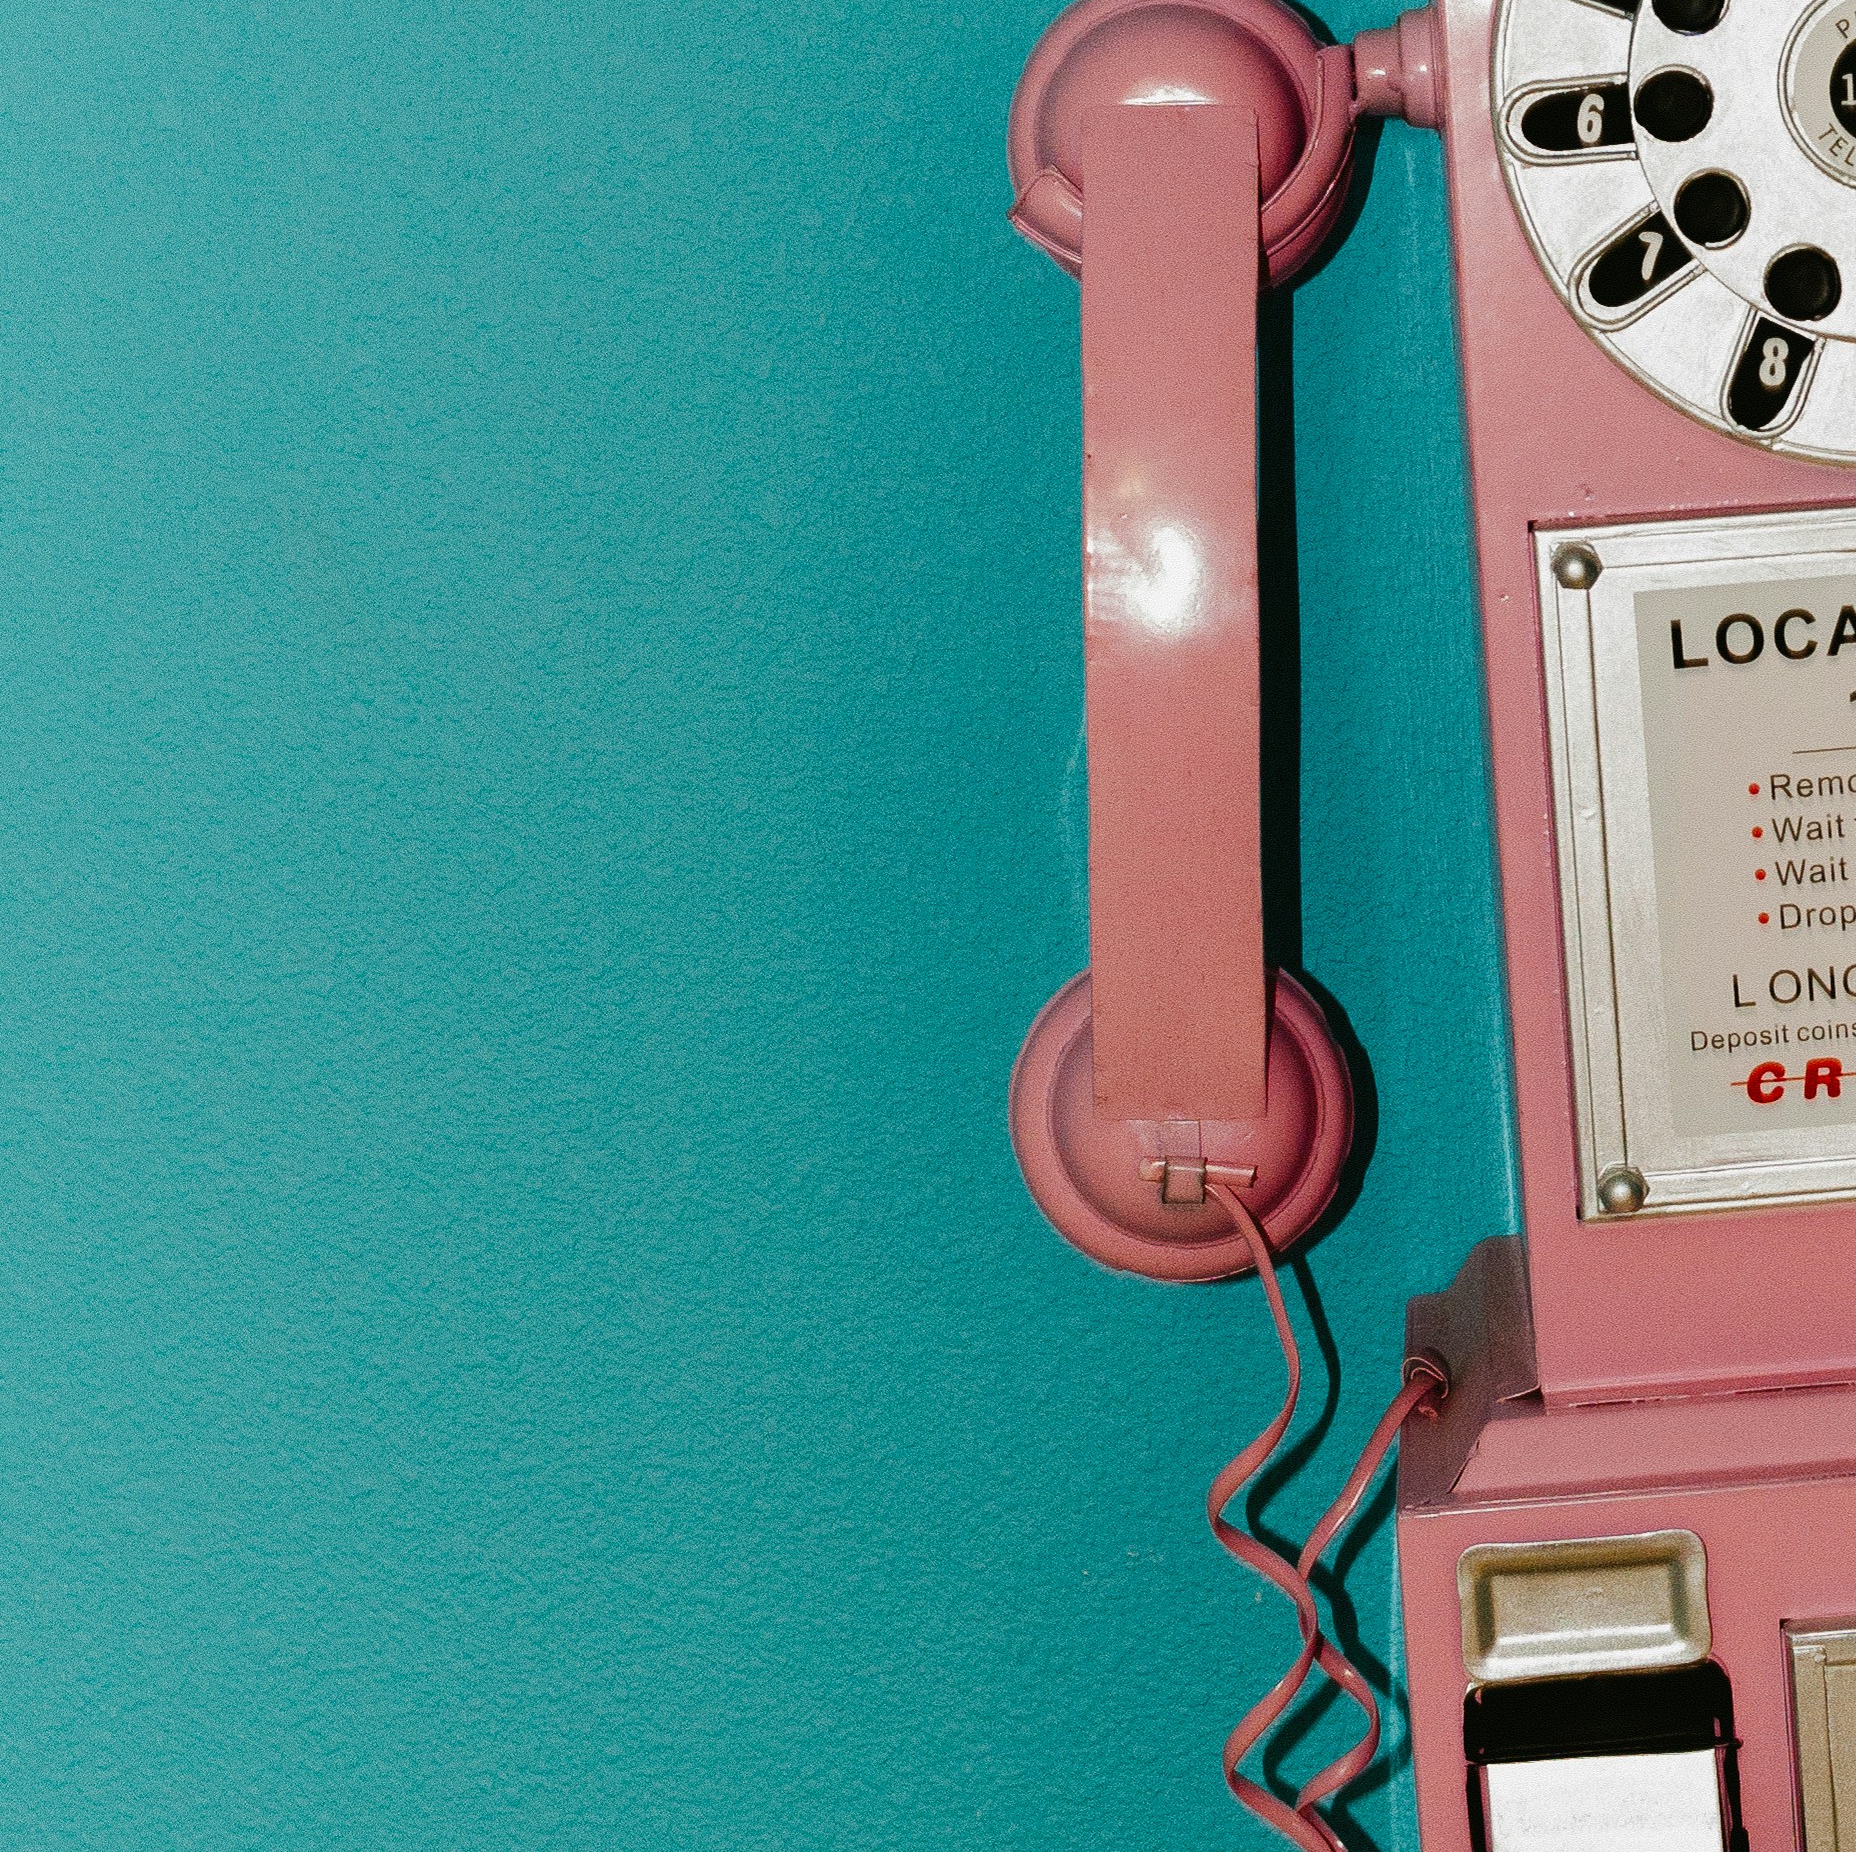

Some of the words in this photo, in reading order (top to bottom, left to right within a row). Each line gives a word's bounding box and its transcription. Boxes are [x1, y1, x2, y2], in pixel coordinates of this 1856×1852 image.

[1576, 93, 1605, 143] 6
[1639, 231, 1665, 280] 7
[1758, 338, 1788, 386] 8
[1772, 814, 1845, 843] Wait
[1775, 857, 1848, 886] Wait
[1690, 1021, 1790, 1054] Deposit
